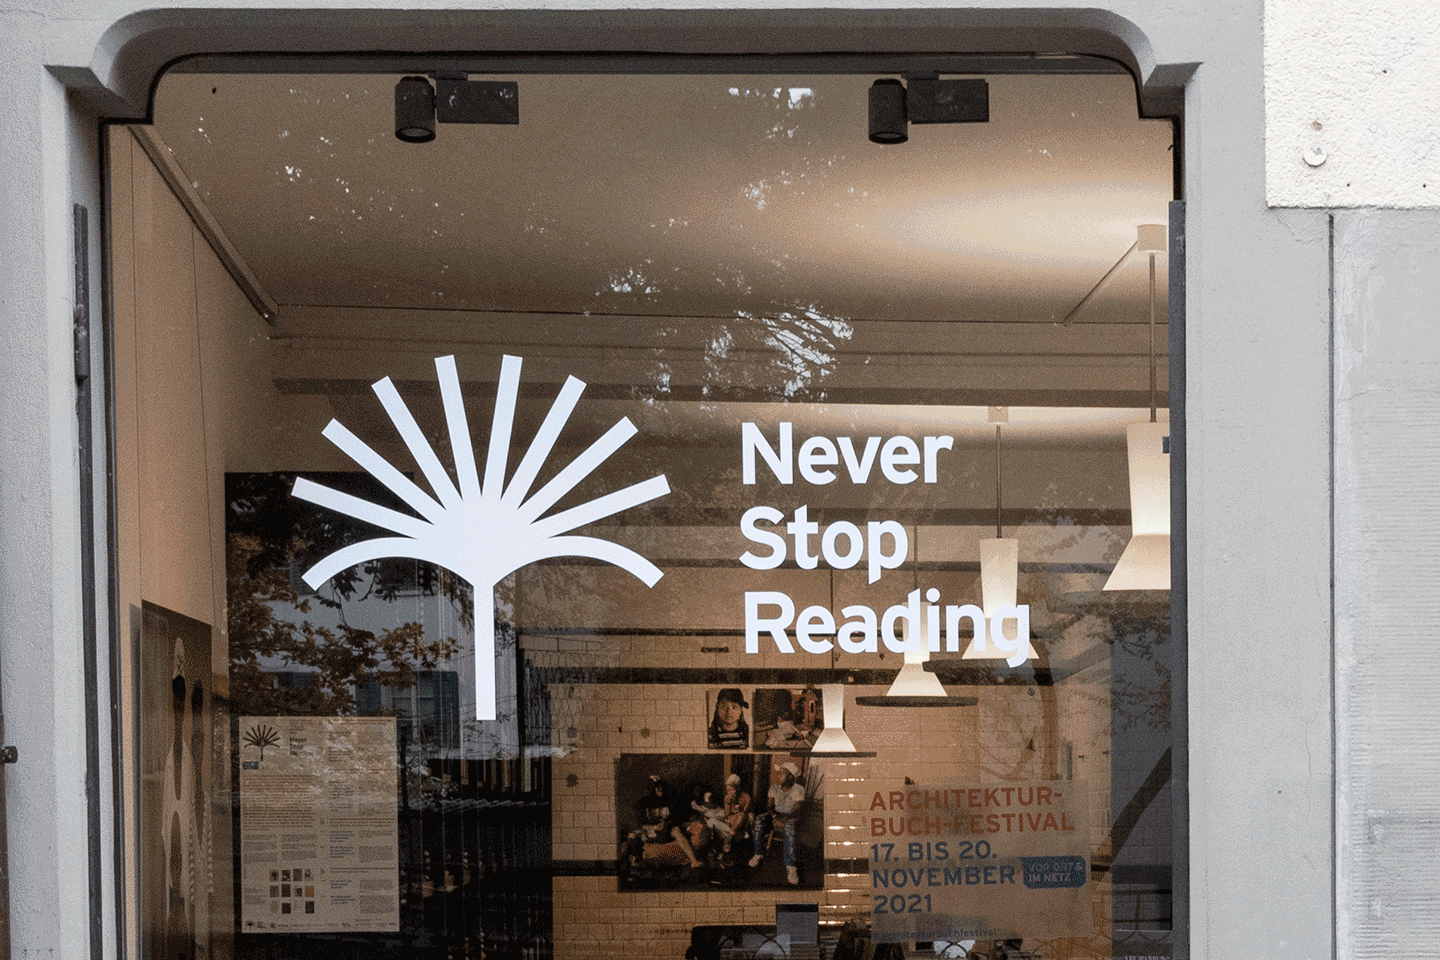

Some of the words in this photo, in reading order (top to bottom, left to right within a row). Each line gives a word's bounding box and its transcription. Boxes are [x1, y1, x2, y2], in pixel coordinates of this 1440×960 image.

[742, 421, 954, 486] Never
[738, 504, 909, 585] Stop
[744, 587, 1031, 669] Reading
[869, 786, 1063, 811] ARCHITEKTUR-
[870, 812, 1075, 837] BUCH-FESTIVAL
[870, 842, 900, 863] 17.
[908, 841, 950, 862] BIS
[958, 839, 998, 861] 20.
[872, 865, 1016, 888] NOVEMBER
[873, 893, 933, 914] 2021
